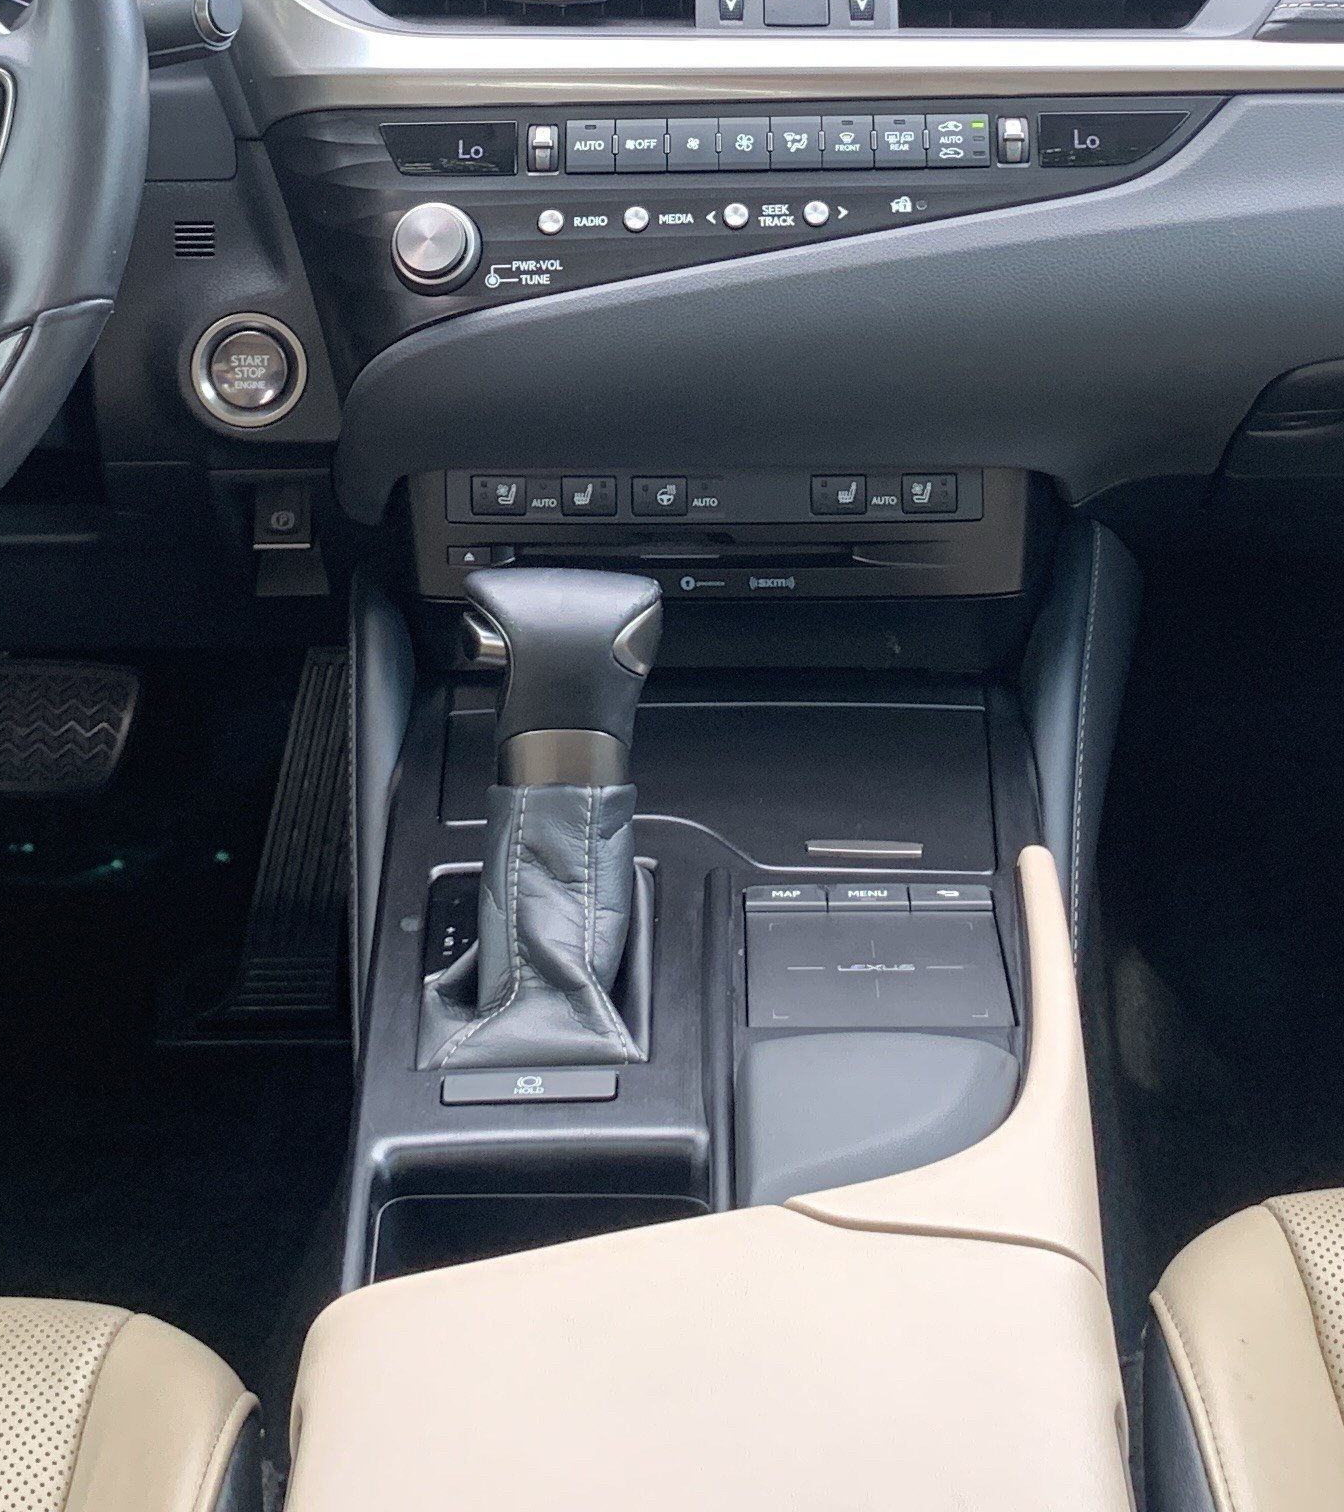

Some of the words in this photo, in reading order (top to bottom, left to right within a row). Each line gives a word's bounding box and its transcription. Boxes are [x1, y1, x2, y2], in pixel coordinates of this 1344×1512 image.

[635, 139, 657, 150] OFF
[939, 135, 964, 144] AUTO
[1073, 129, 1100, 149] Lo
[458, 139, 484, 160] Lo
[574, 140, 605, 151] AUTO
[835, 143, 860, 152] FRONT
[889, 142, 910, 151] REAR
[762, 204, 790, 216] SEEK
[573, 216, 608, 227] RADIO
[659, 213, 694, 225] MEDIA
[758, 216, 795, 227] TRACK
[520, 274, 550, 285] TUNE
[231, 355, 270, 366] START
[234, 367, 266, 379] STOP
[234, 381, 266, 389] ENGINE
[531, 498, 557, 508] AUTO
[692, 497, 718, 507] AUTO
[871, 495, 897, 505] AUTO
[771, 890, 801, 898] MAP
[848, 890, 888, 898] MENU
[444, 936, 454, 947] S
[513, 1086, 544, 1095] HOLD
